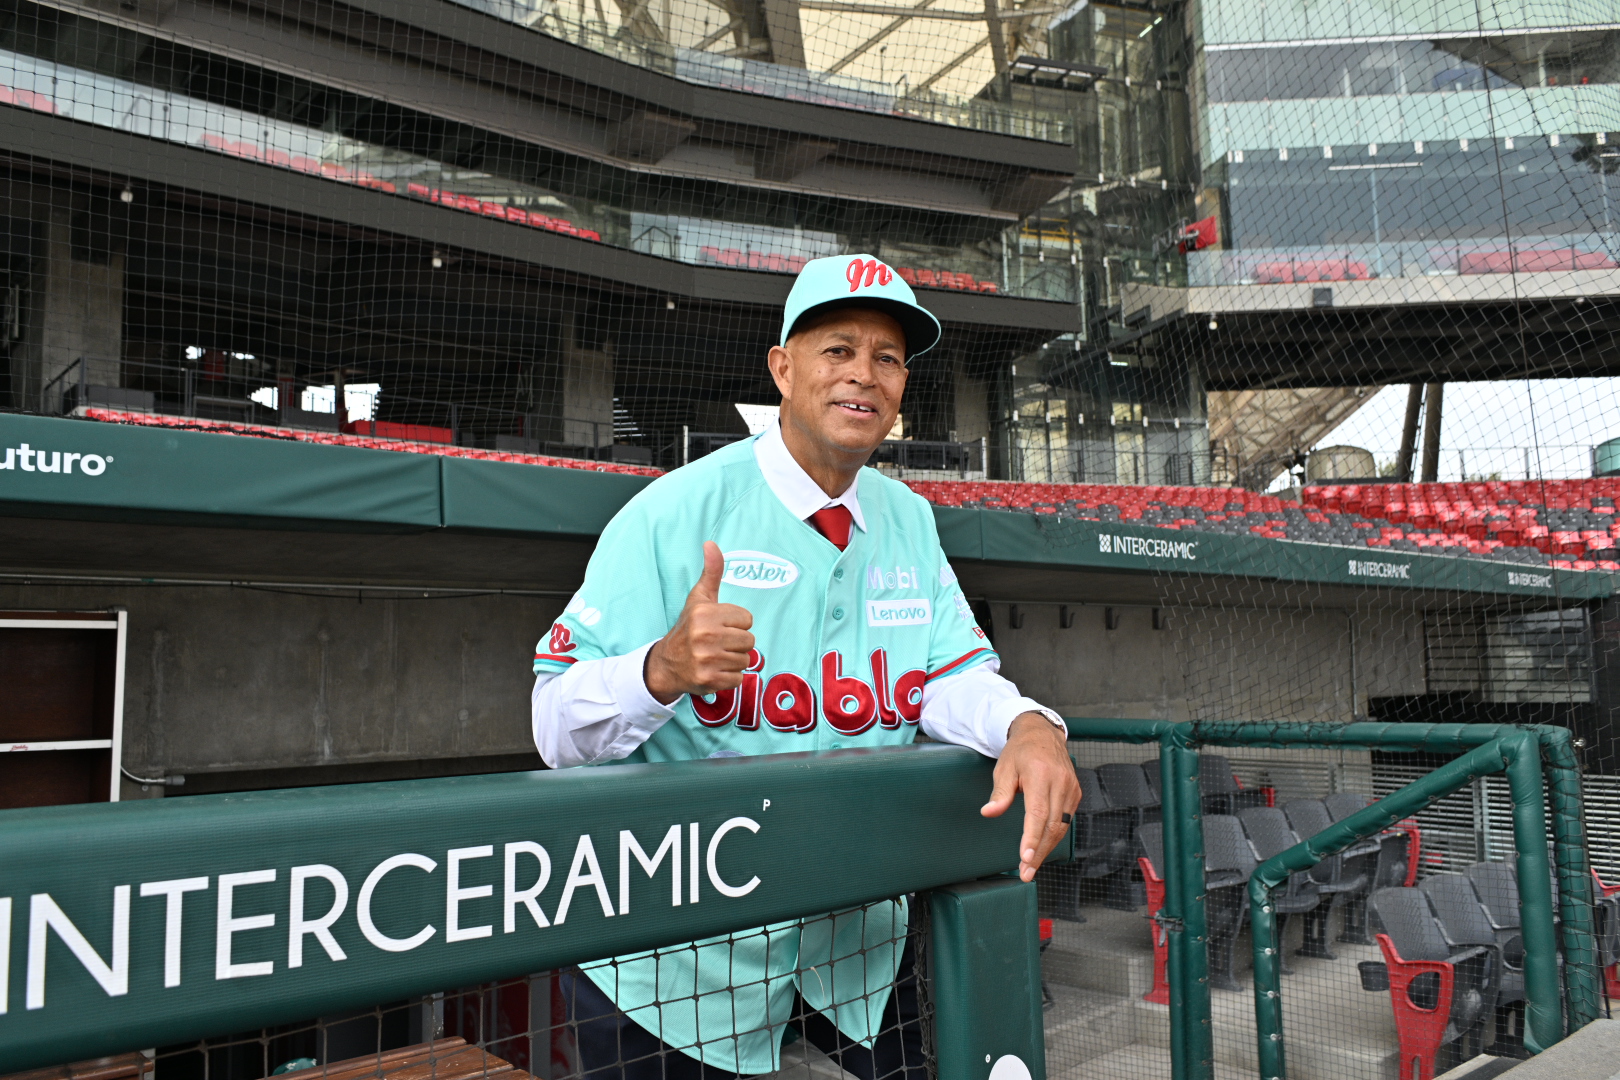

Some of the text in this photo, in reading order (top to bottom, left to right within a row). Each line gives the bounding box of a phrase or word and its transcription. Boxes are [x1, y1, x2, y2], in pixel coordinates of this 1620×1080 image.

[1113, 535, 1196, 560] INTERCERAMIC
[866, 565, 919, 590] Mobi
[871, 605, 927, 621] Lenovo
